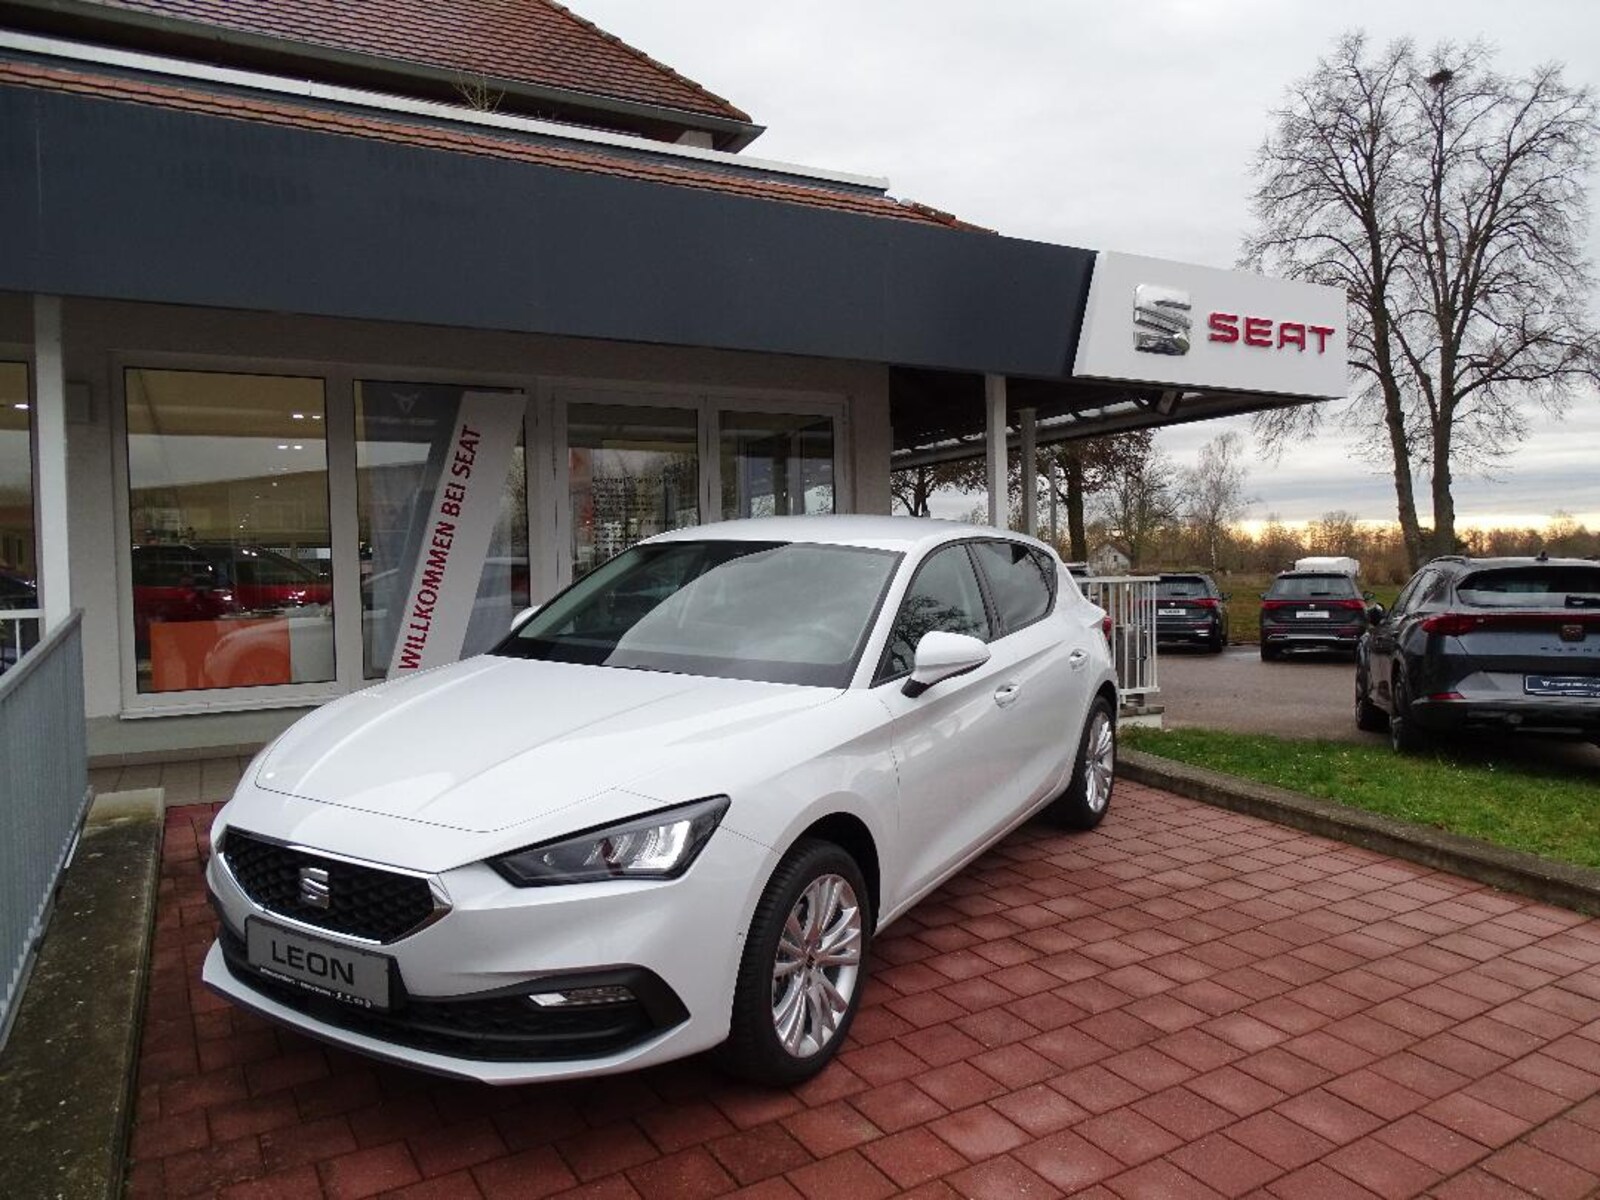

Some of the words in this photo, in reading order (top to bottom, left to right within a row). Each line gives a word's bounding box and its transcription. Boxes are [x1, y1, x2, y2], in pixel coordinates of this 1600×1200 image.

[1207, 312, 1335, 354] SEAT
[451, 424, 481, 480] SEAT
[441, 484, 467, 518] BEI
[398, 521, 456, 670] WILLKOMMEN
[271, 939, 355, 986] LEON
